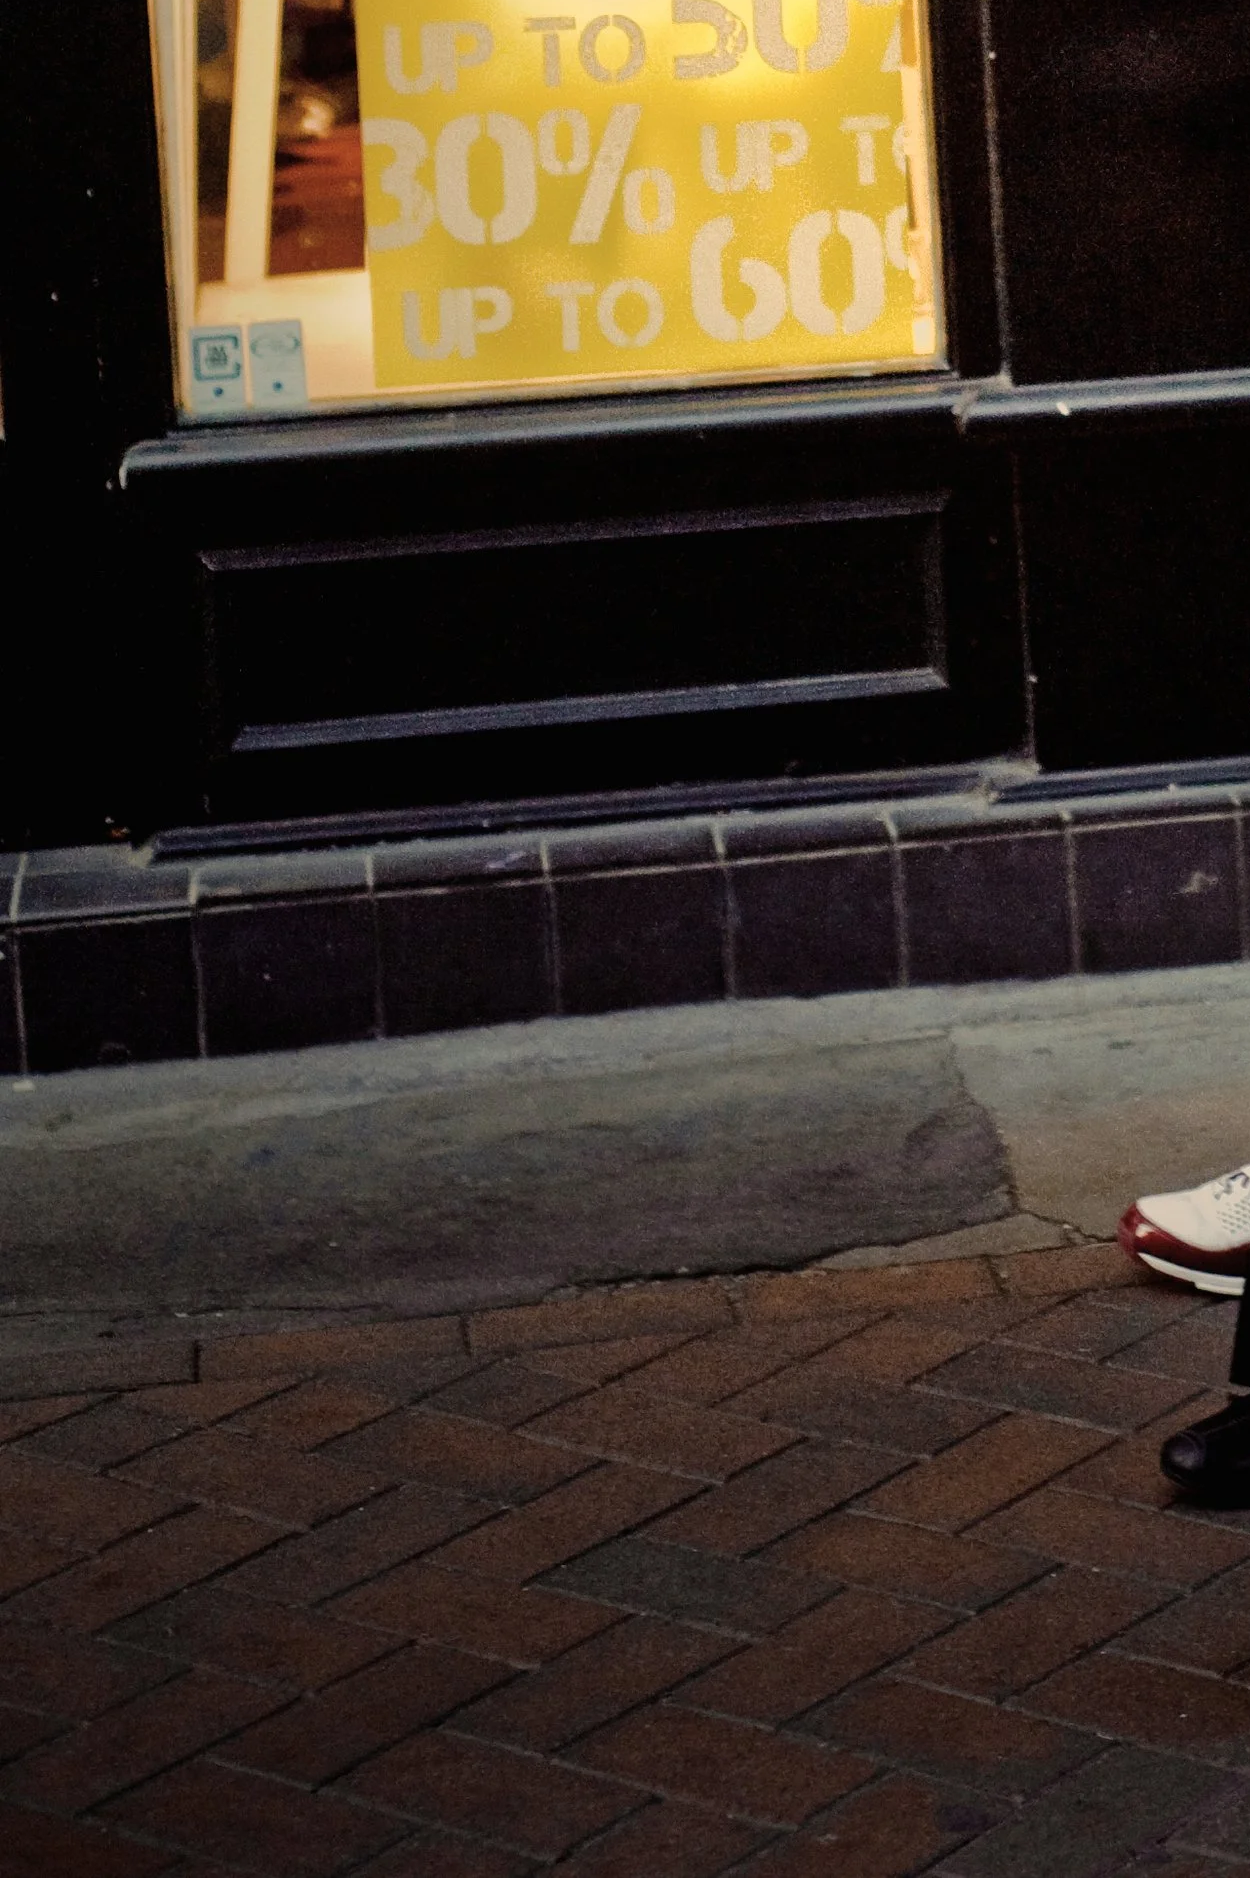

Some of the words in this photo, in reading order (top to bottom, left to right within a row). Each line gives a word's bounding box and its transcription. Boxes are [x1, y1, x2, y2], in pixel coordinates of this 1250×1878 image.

[383, 20, 494, 94] UP
[523, 14, 647, 87] TO
[363, 103, 676, 252] 30%
[701, 119, 808, 193] UP
[403, 285, 513, 360] UP
[543, 277, 664, 351] TO
